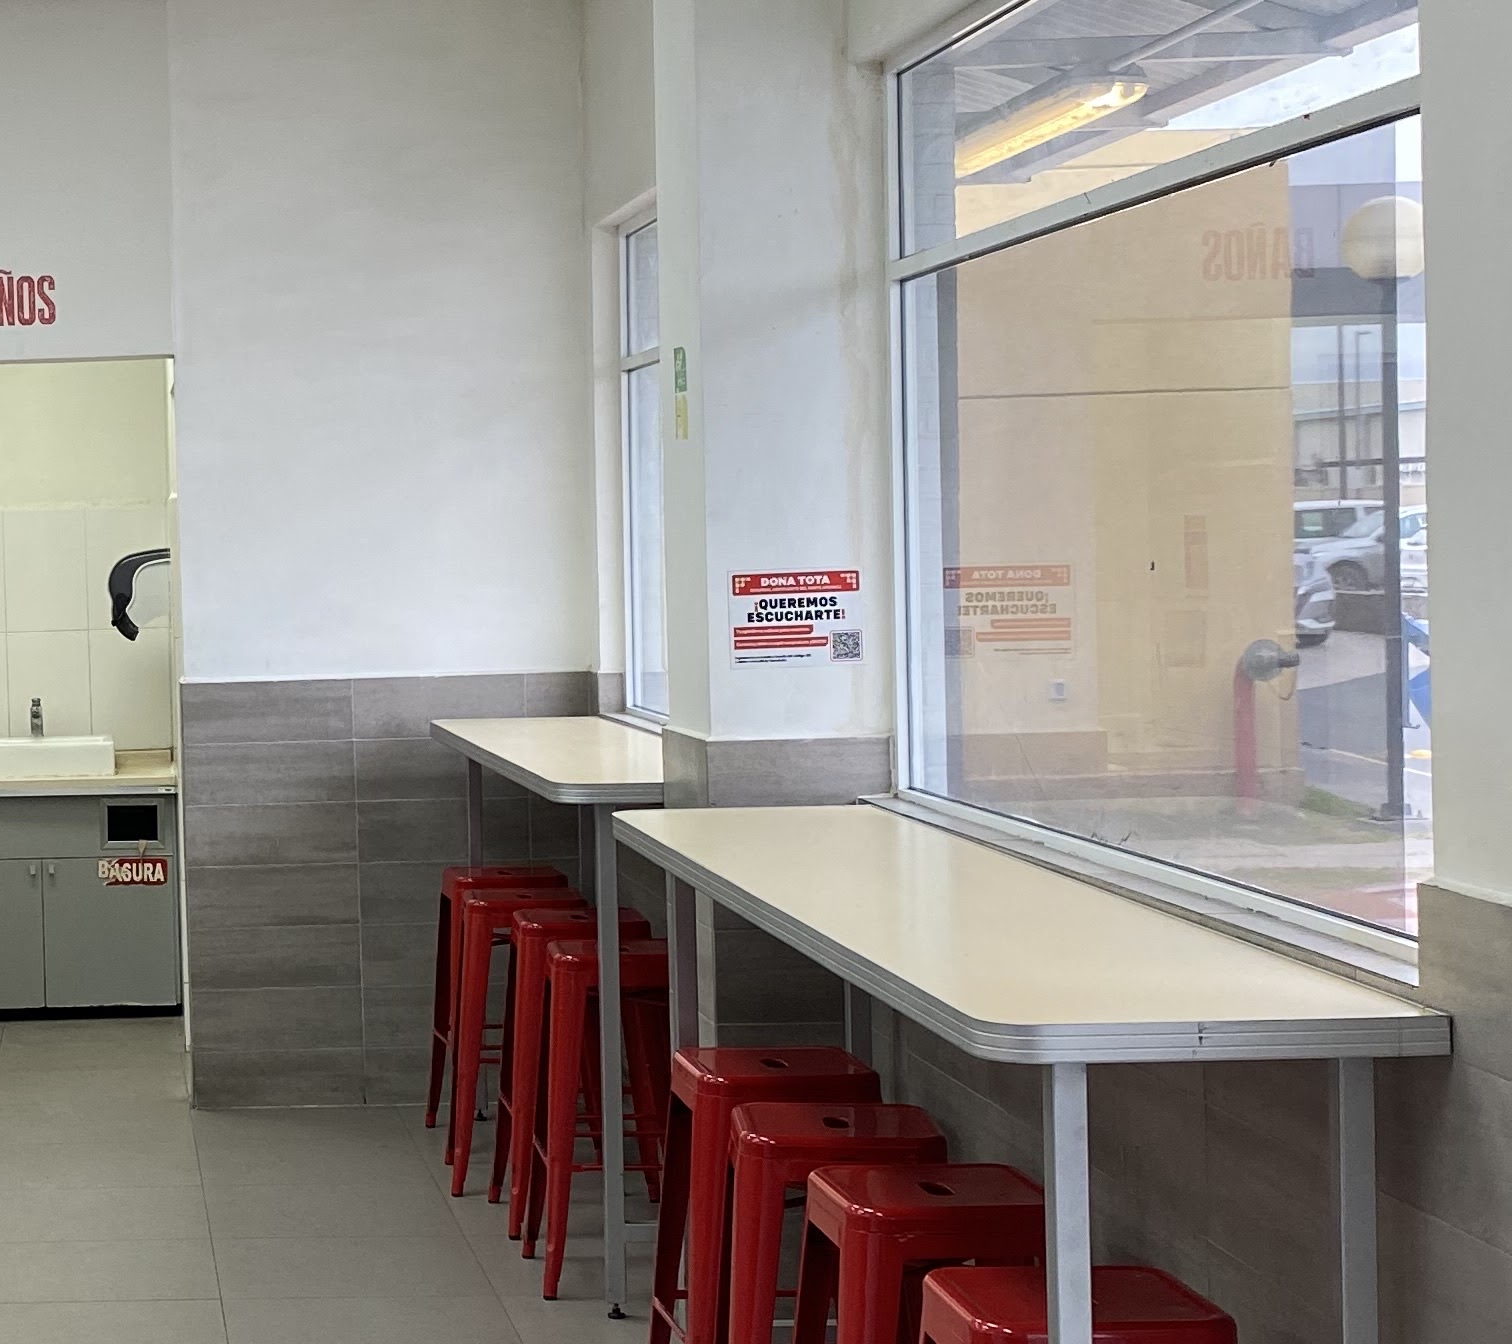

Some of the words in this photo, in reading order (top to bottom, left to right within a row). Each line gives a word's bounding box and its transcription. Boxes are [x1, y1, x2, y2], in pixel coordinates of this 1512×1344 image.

[797, 574, 831, 586] TOTA
[754, 596, 838, 613] ¡QUEREMOS
[747, 608, 846, 623] ESCUCHARTE!
[97, 859, 166, 883] BASURA
